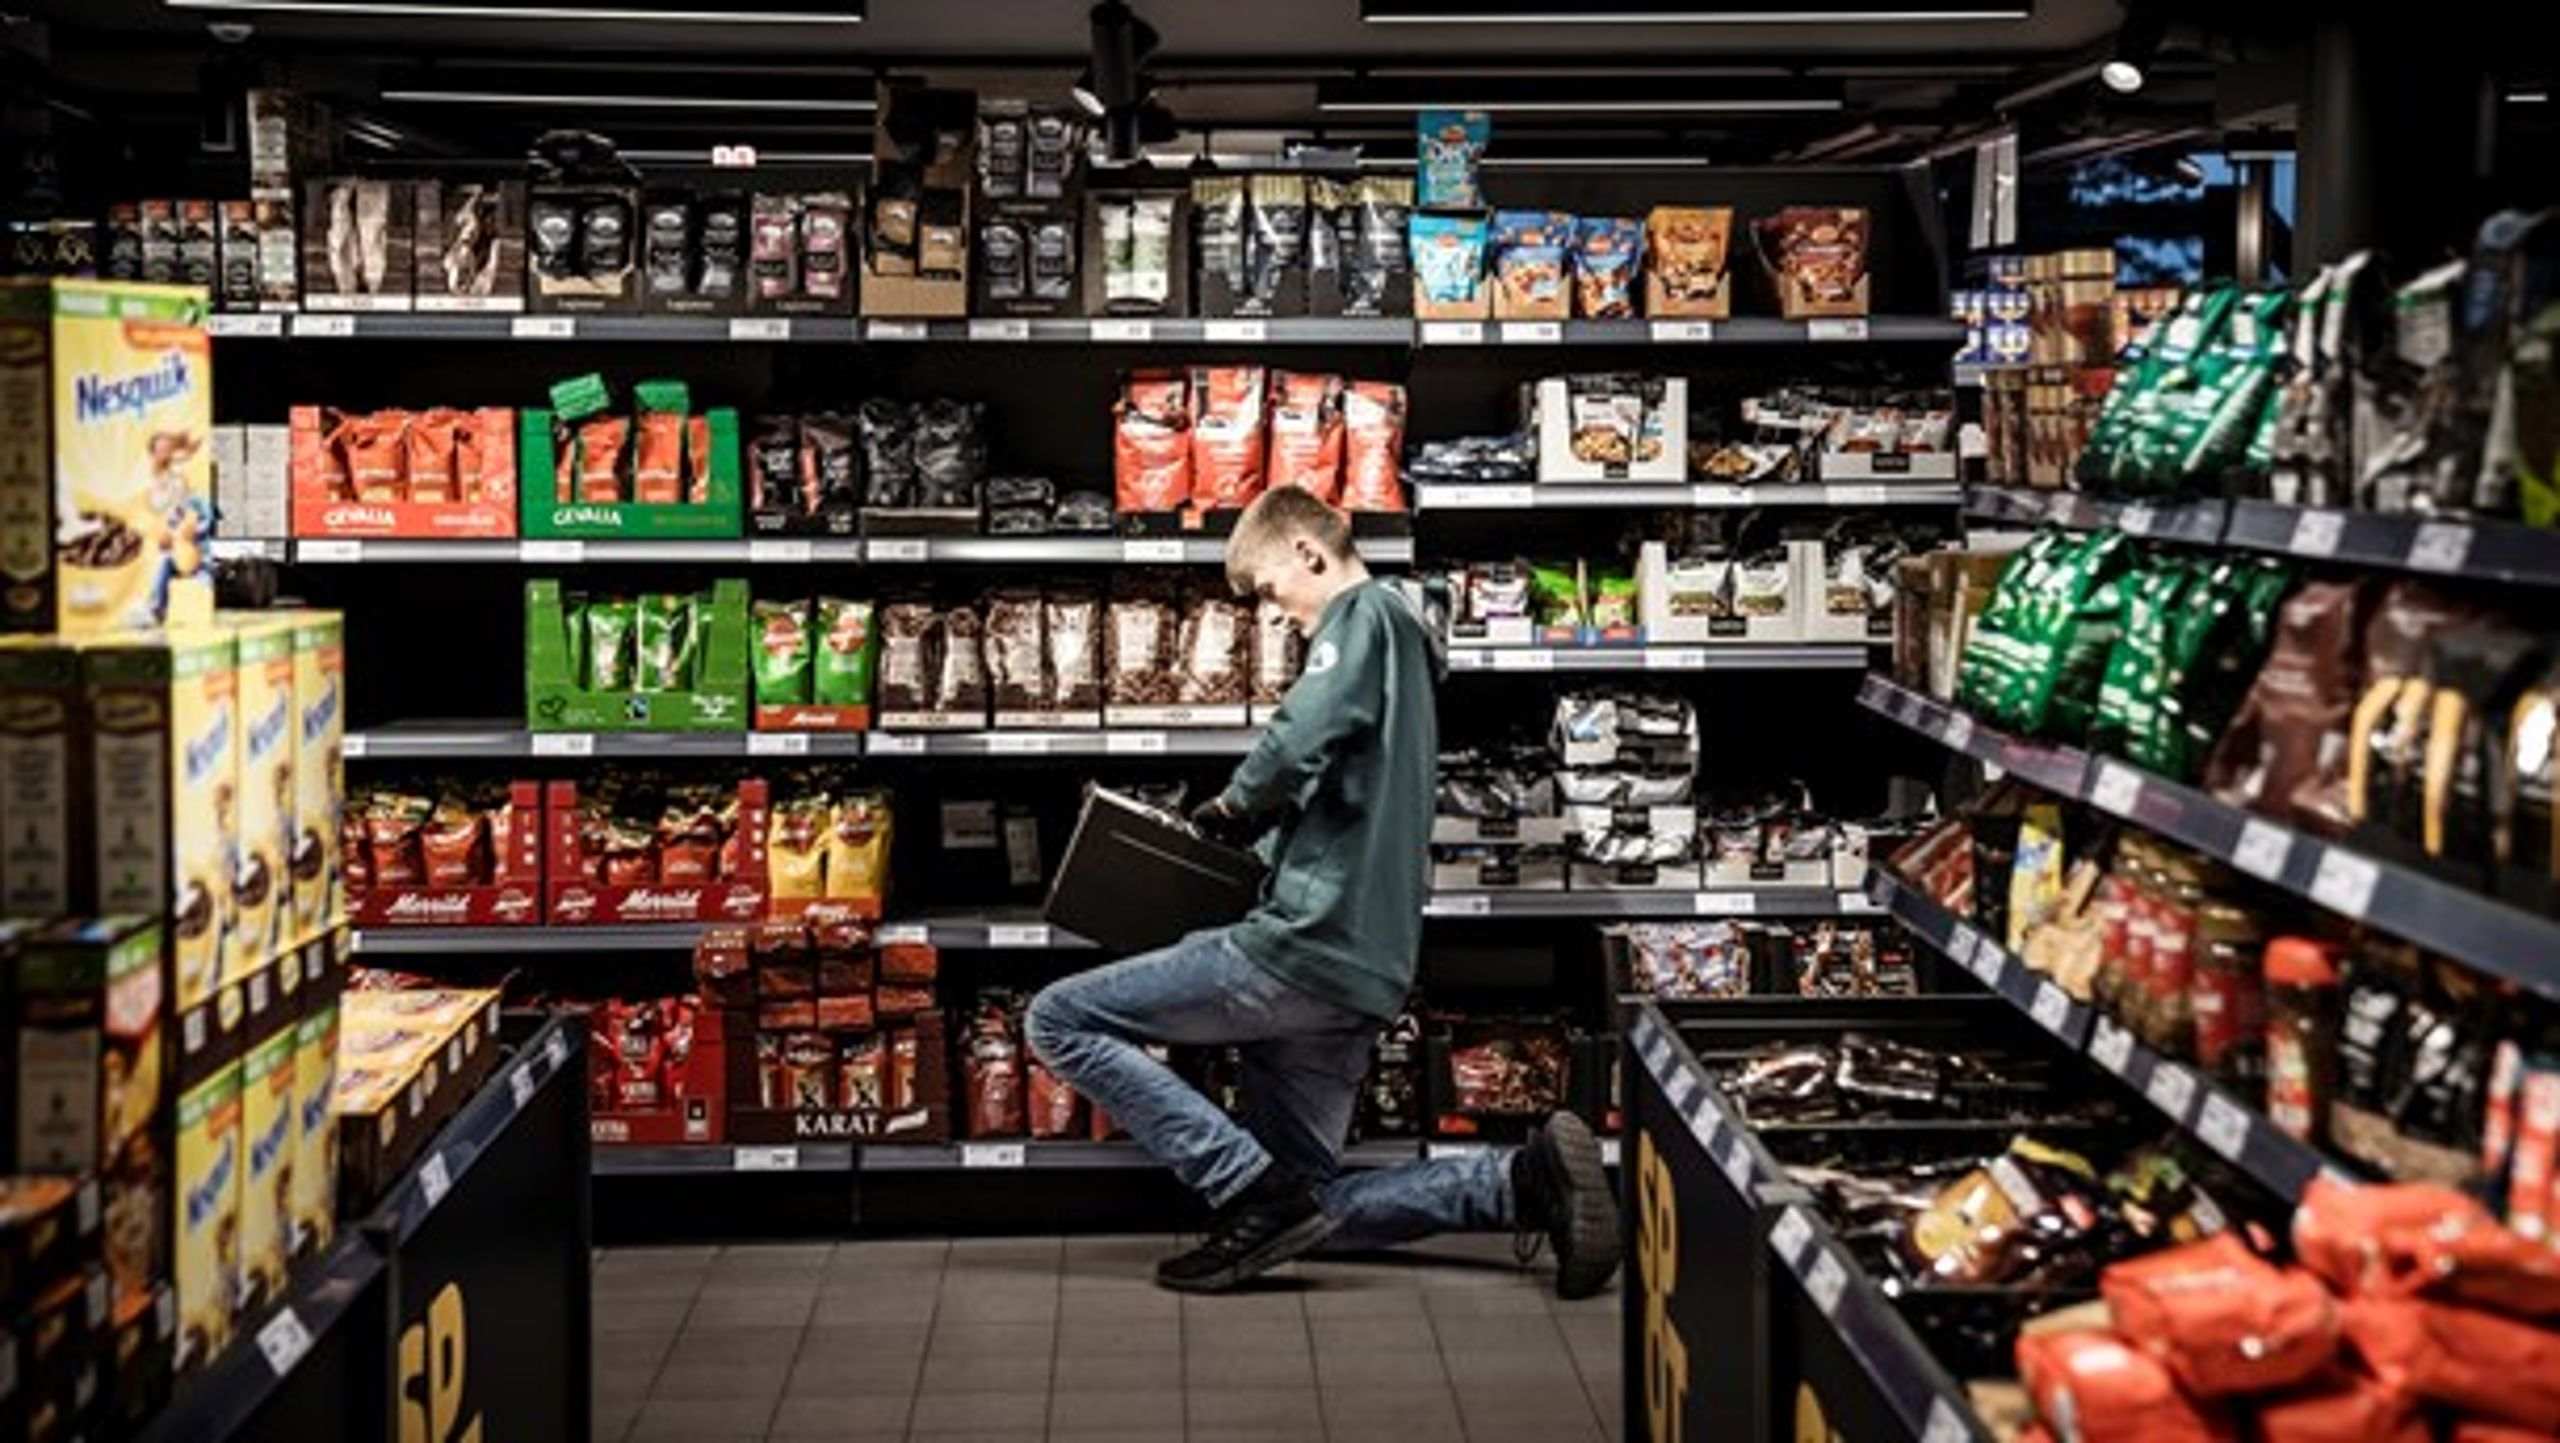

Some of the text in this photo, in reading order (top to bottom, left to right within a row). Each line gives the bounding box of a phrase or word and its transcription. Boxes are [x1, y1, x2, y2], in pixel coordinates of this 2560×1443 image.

[76, 353, 188, 422] Nesquik
[323, 507, 396, 526] GEVALIA
[552, 507, 622, 526] GEVALIA
[796, 1113, 879, 1135] KARAT
